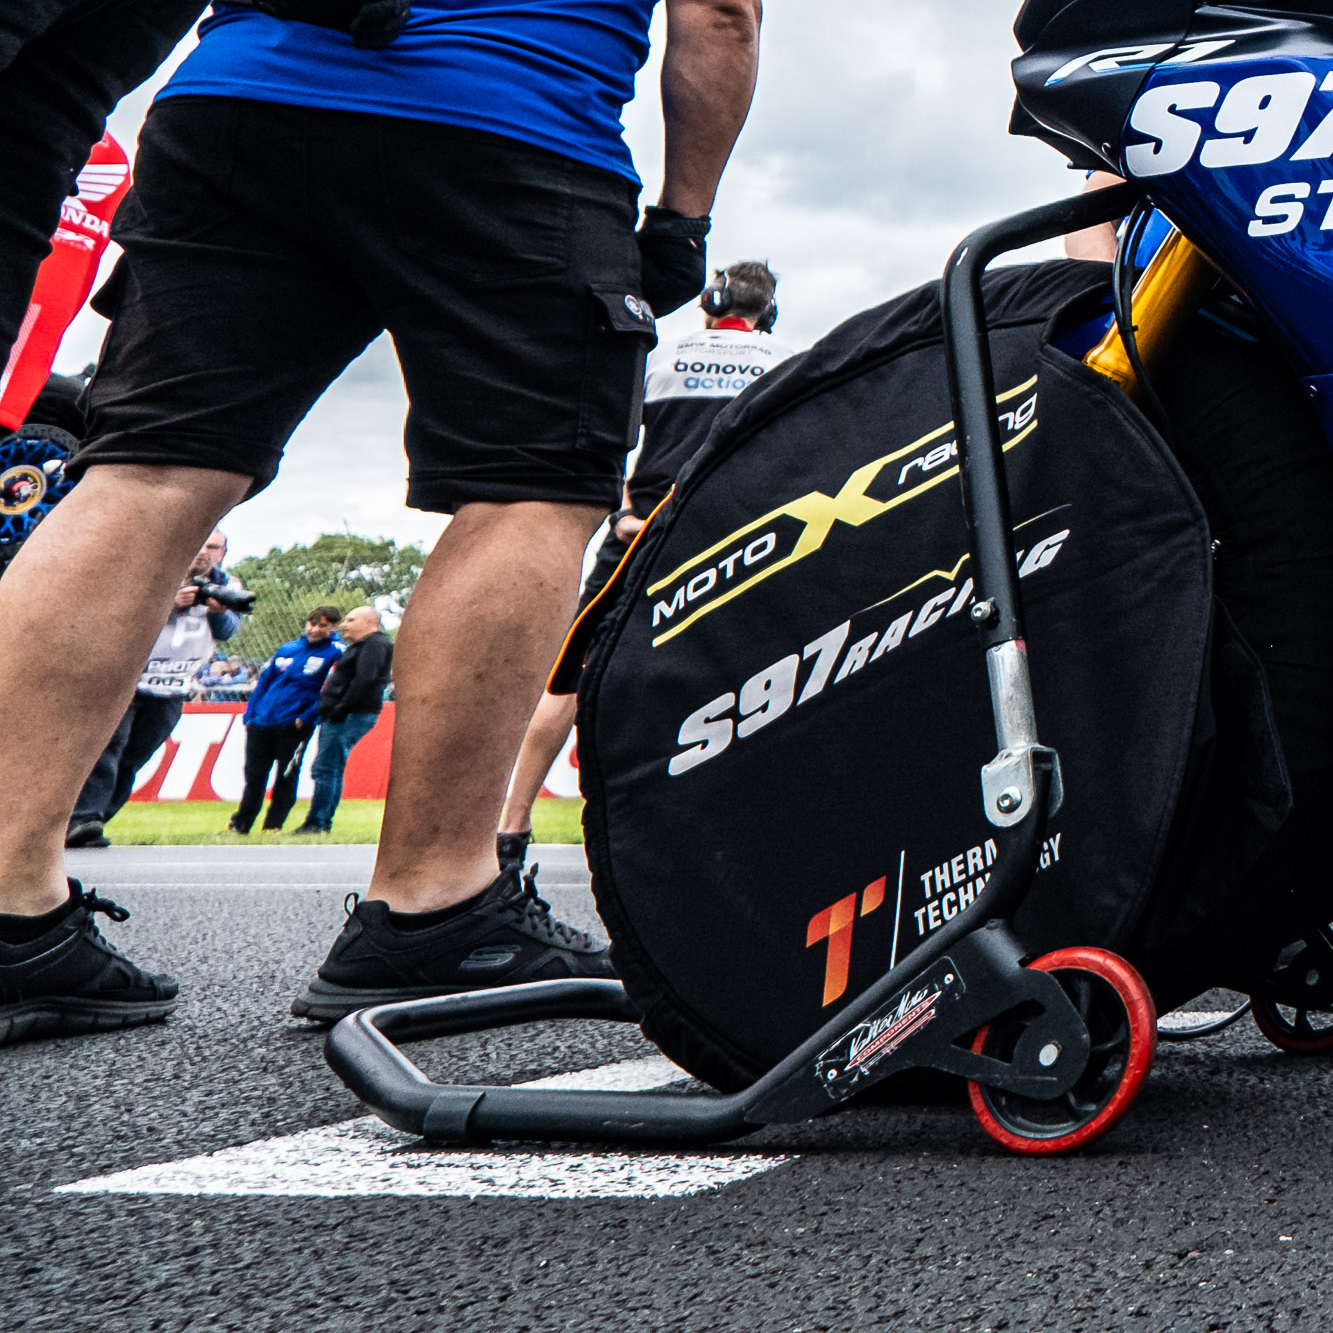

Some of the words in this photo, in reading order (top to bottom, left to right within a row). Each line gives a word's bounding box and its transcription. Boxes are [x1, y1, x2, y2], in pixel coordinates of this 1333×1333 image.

[673, 358, 765, 377] bonovo
[683, 375, 752, 391] actio
[897, 392, 1039, 485] rang
